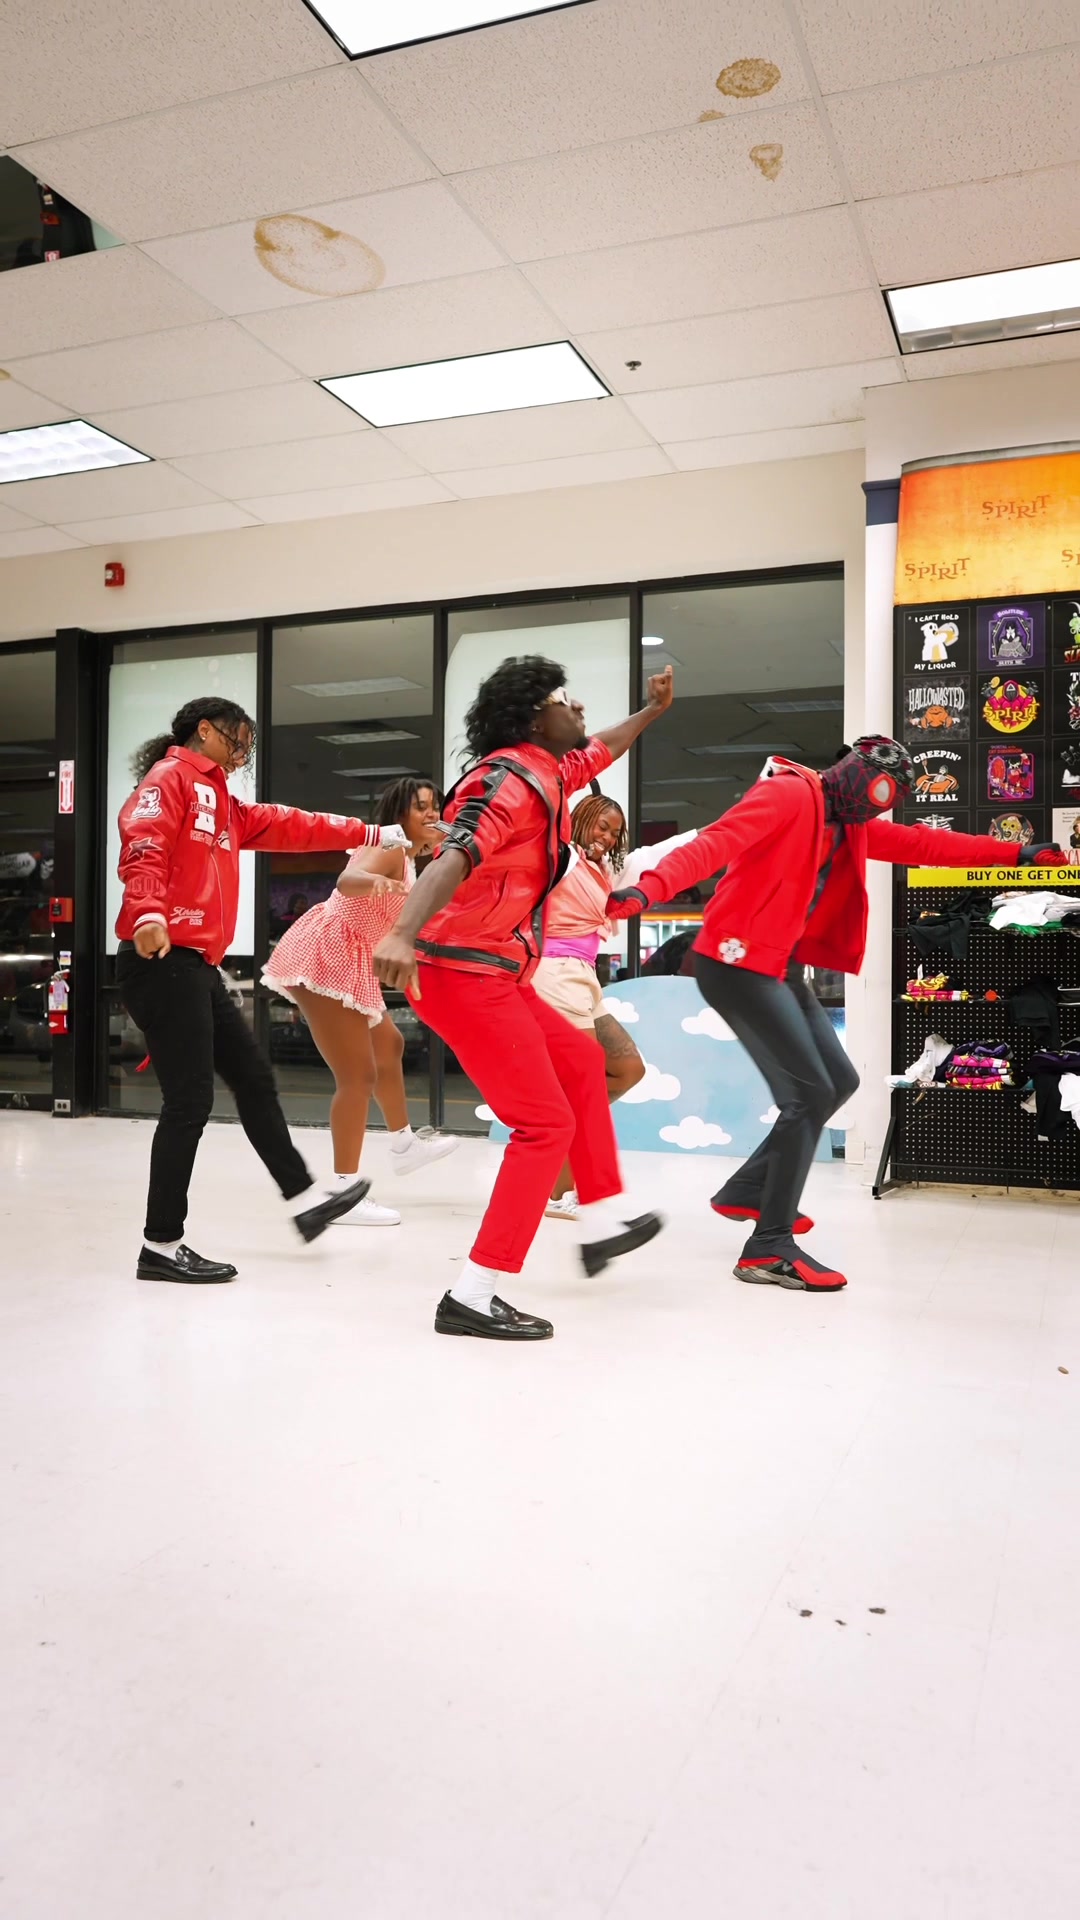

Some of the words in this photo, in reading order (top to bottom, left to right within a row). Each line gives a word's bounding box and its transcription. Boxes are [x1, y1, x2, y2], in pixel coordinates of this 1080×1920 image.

[982, 494, 1051, 519] SPIRIT
[905, 557, 970, 580] SPIRIT
[919, 614, 940, 622] CAN'T
[928, 661, 957, 670] LIQUOR
[908, 686, 965, 712] HALLOWASTED
[983, 703, 1040, 722] SPIRIT
[913, 750, 962, 764] CREEPIN'
[930, 793, 959, 802] REAL
[967, 871, 992, 881] BUY
[996, 870, 1023, 880] ONE
[1027, 870, 1053, 880] GET
